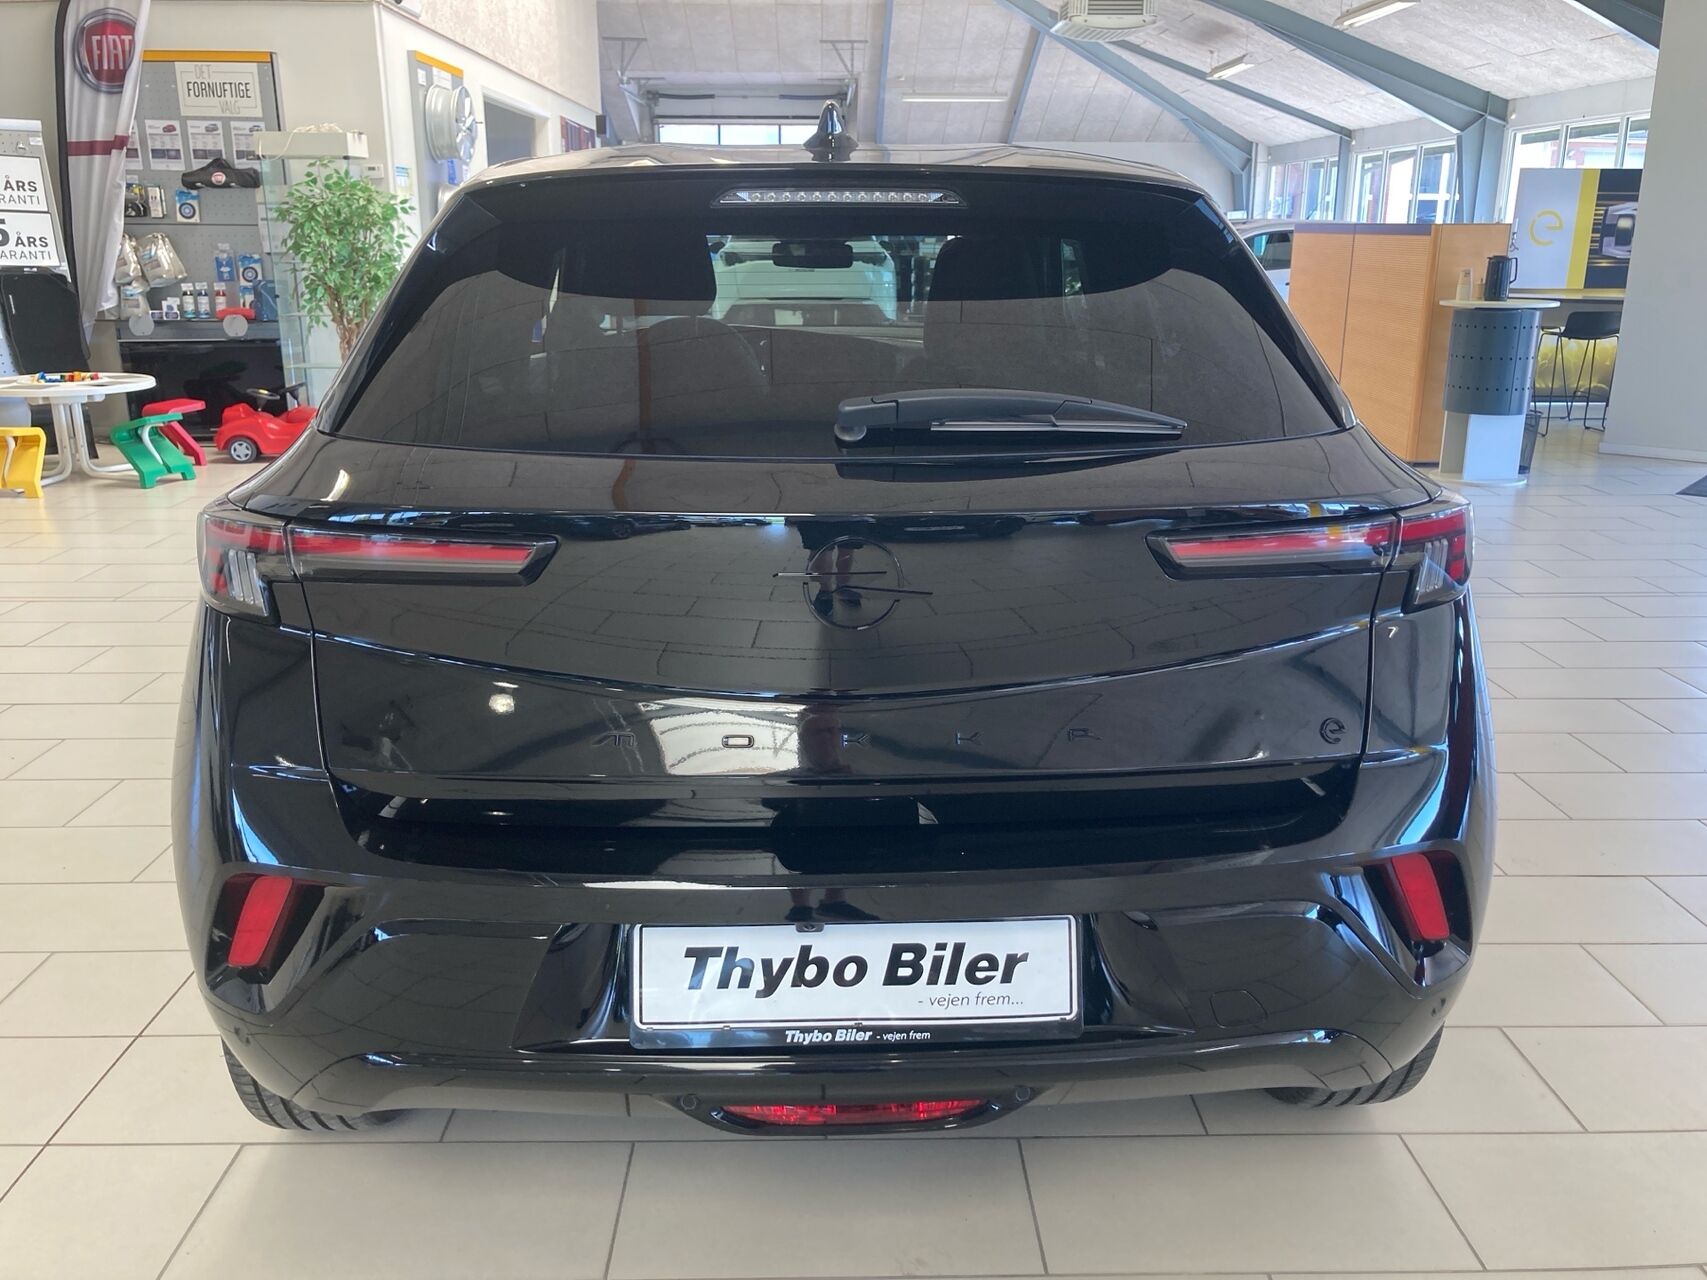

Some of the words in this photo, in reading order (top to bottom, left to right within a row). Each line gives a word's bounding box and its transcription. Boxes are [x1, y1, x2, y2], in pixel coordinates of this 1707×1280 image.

[91, 35, 133, 70] FIAT
[194, 64, 211, 79] DET
[186, 81, 252, 99] FORNUFTIGE
[3, 175, 38, 193] ÅRS
[15, 231, 49, 248] ÅRS
[684, 944, 869, 999] Thybo
[882, 942, 1030, 987] Biler
[928, 995, 971, 1009] vejen
[974, 991, 1025, 1007] frem...
[785, 1030, 833, 1045] Thybo
[834, 1029, 873, 1043] Biler
[882, 1032, 908, 1042] vejen
[909, 1031, 932, 1041] frem
